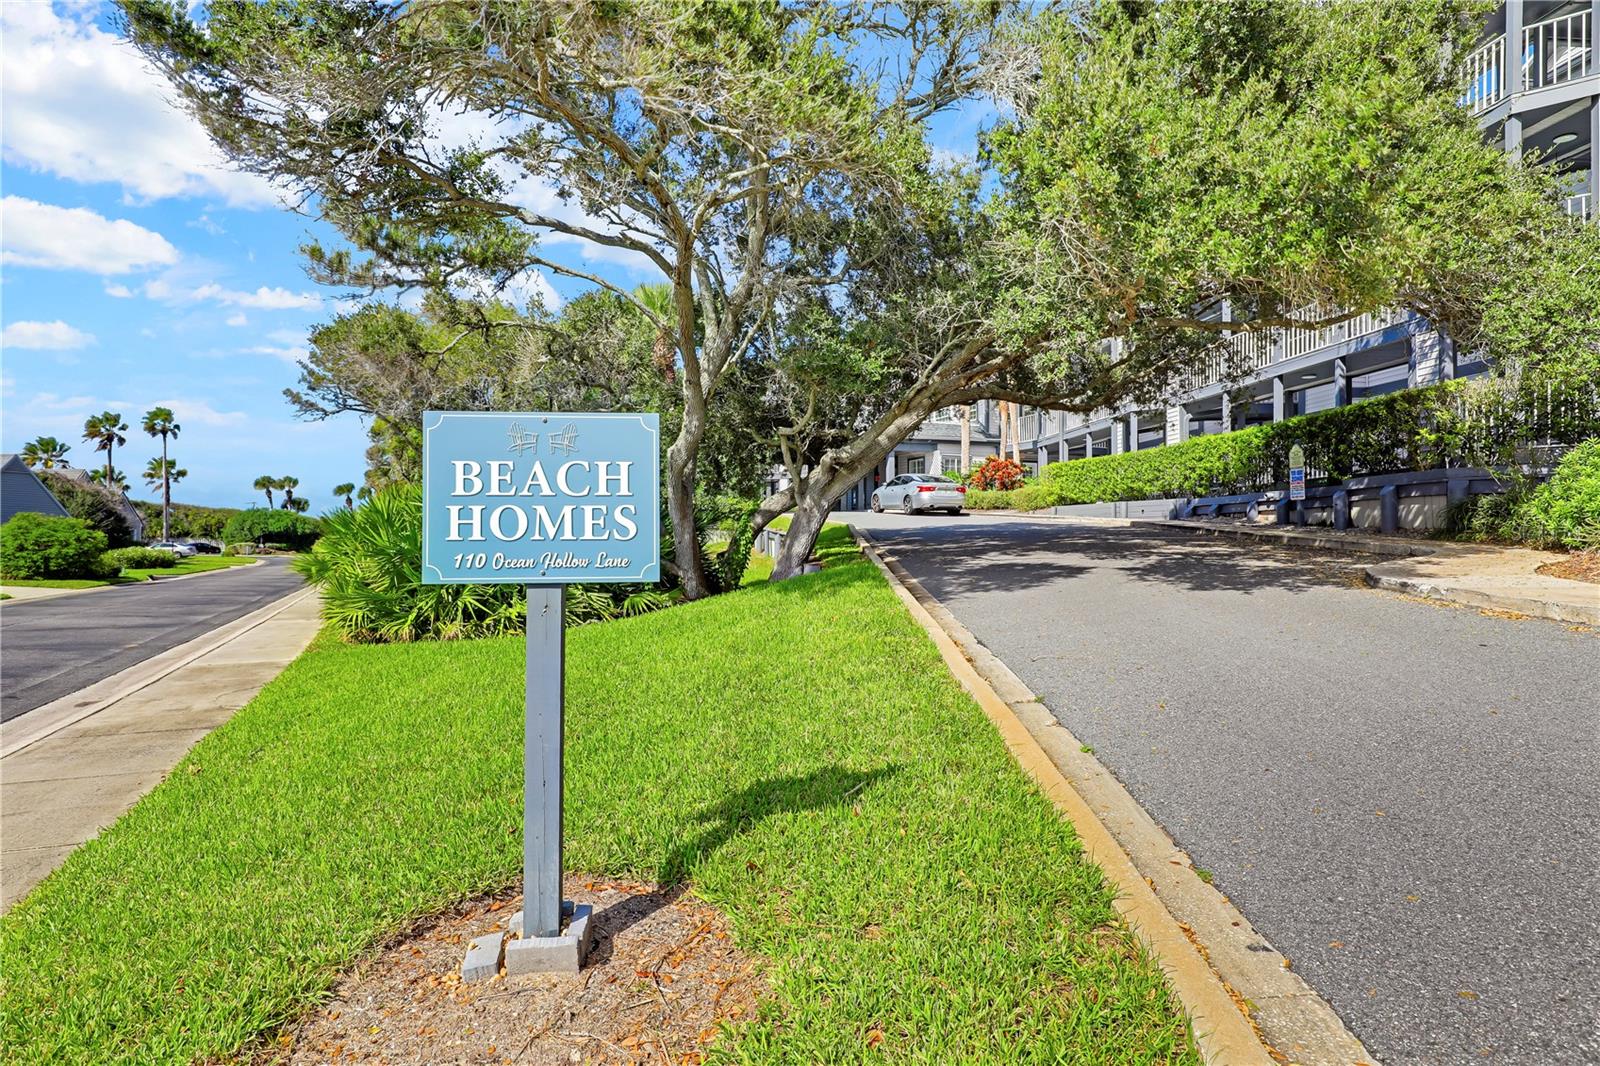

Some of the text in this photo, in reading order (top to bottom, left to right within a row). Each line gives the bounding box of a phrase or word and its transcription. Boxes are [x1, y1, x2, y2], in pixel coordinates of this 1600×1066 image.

[451, 460, 633, 497] BEACH
[445, 504, 638, 542] HOMES
[454, 552, 631, 571] 110 Ocean Hollow Lane
